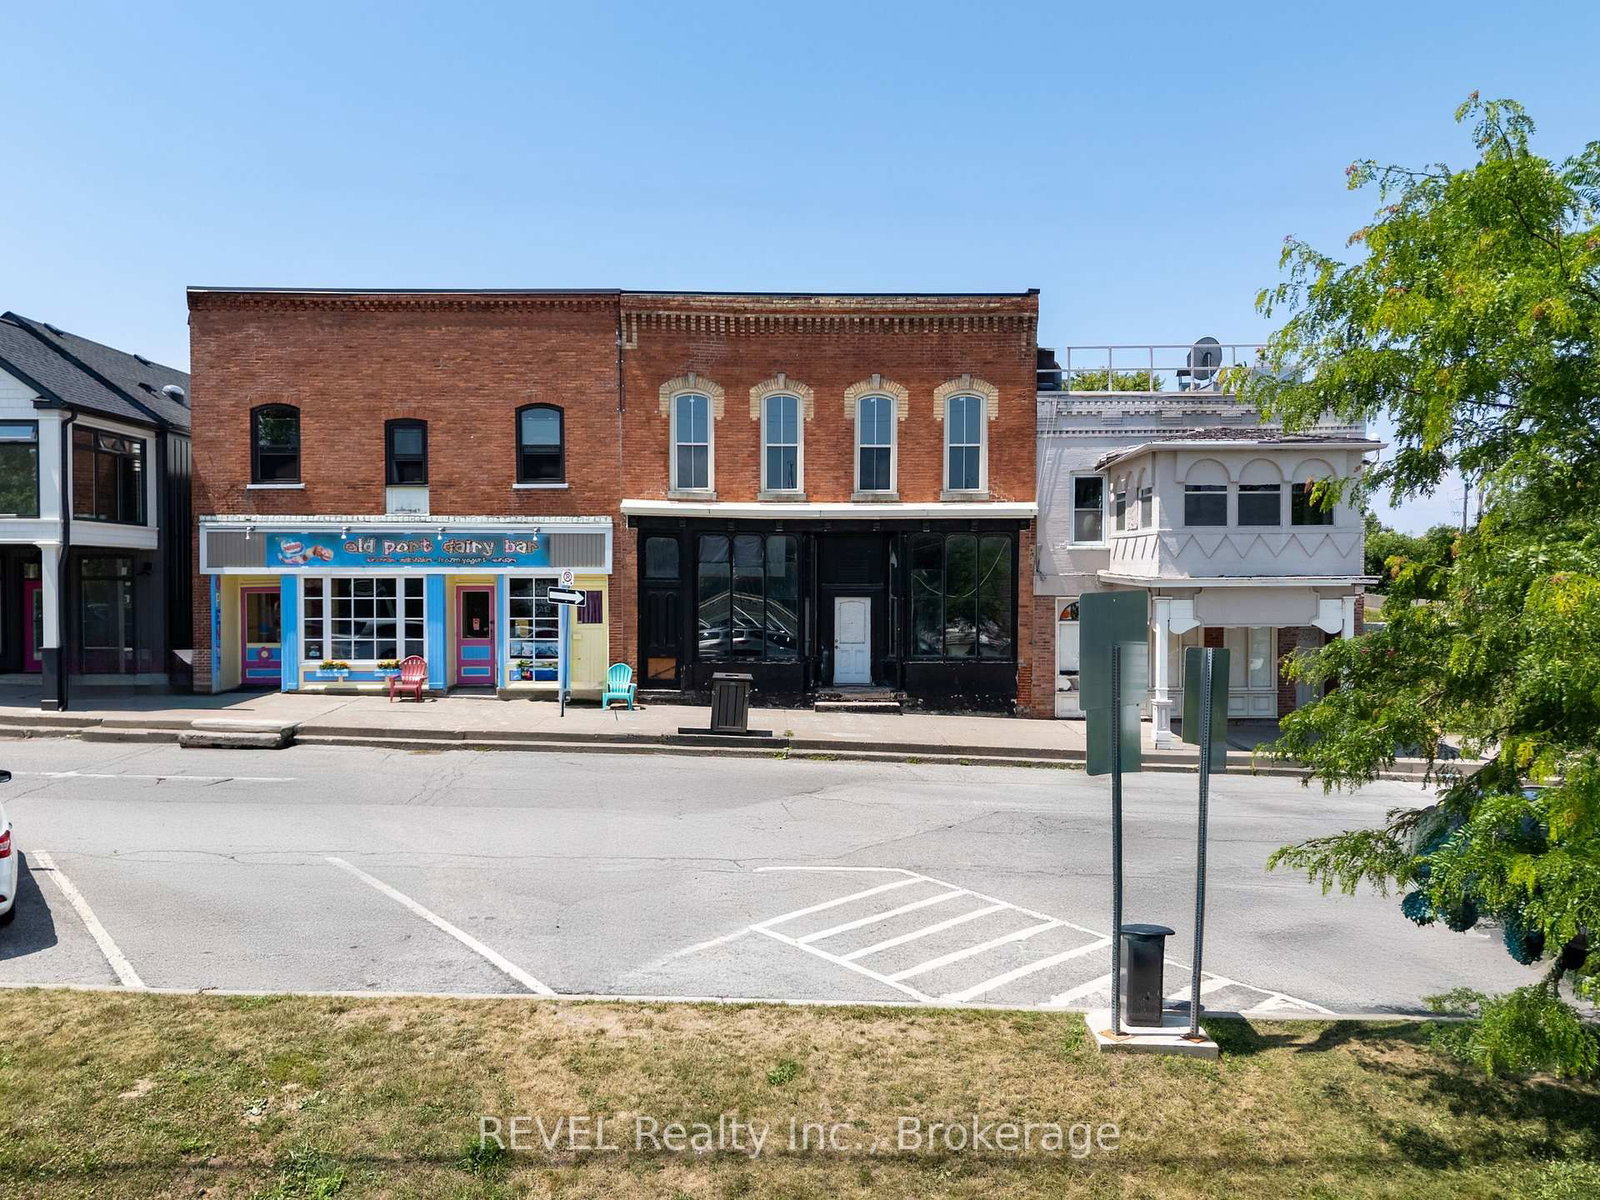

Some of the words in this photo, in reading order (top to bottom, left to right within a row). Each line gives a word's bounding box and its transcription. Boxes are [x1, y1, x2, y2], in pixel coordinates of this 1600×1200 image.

[344, 537, 376, 553] old
[383, 538, 433, 556] port
[442, 539, 494, 556] dairy
[503, 539, 539, 553] bar
